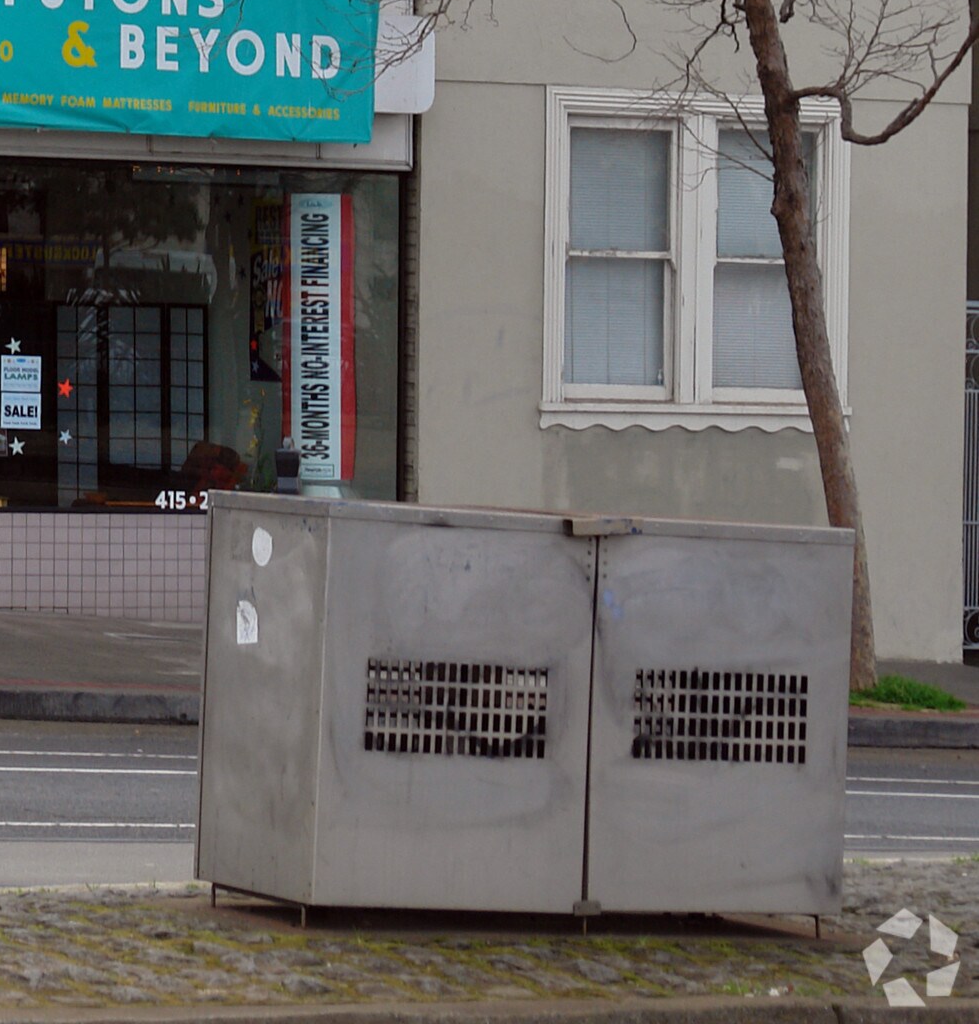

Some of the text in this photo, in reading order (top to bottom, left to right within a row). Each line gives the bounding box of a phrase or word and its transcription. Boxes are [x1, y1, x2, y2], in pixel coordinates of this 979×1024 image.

[61, 20, 341, 79] & BEYOND
[2, 91, 54, 106] MEMORY
[61, 94, 96, 108] FOAM
[103, 95, 173, 112] MATTRESSES
[188, 100, 247, 115] FURNITURE
[268, 104, 340, 121] ACCESSORIES
[301, 213, 330, 287] FINANCING
[301, 291, 330, 379] NO-INTEREST
[4, 373, 40, 381] LAMPS
[4, 404, 38, 418] SALE!
[301, 384, 330, 460] 36-MONTHS
